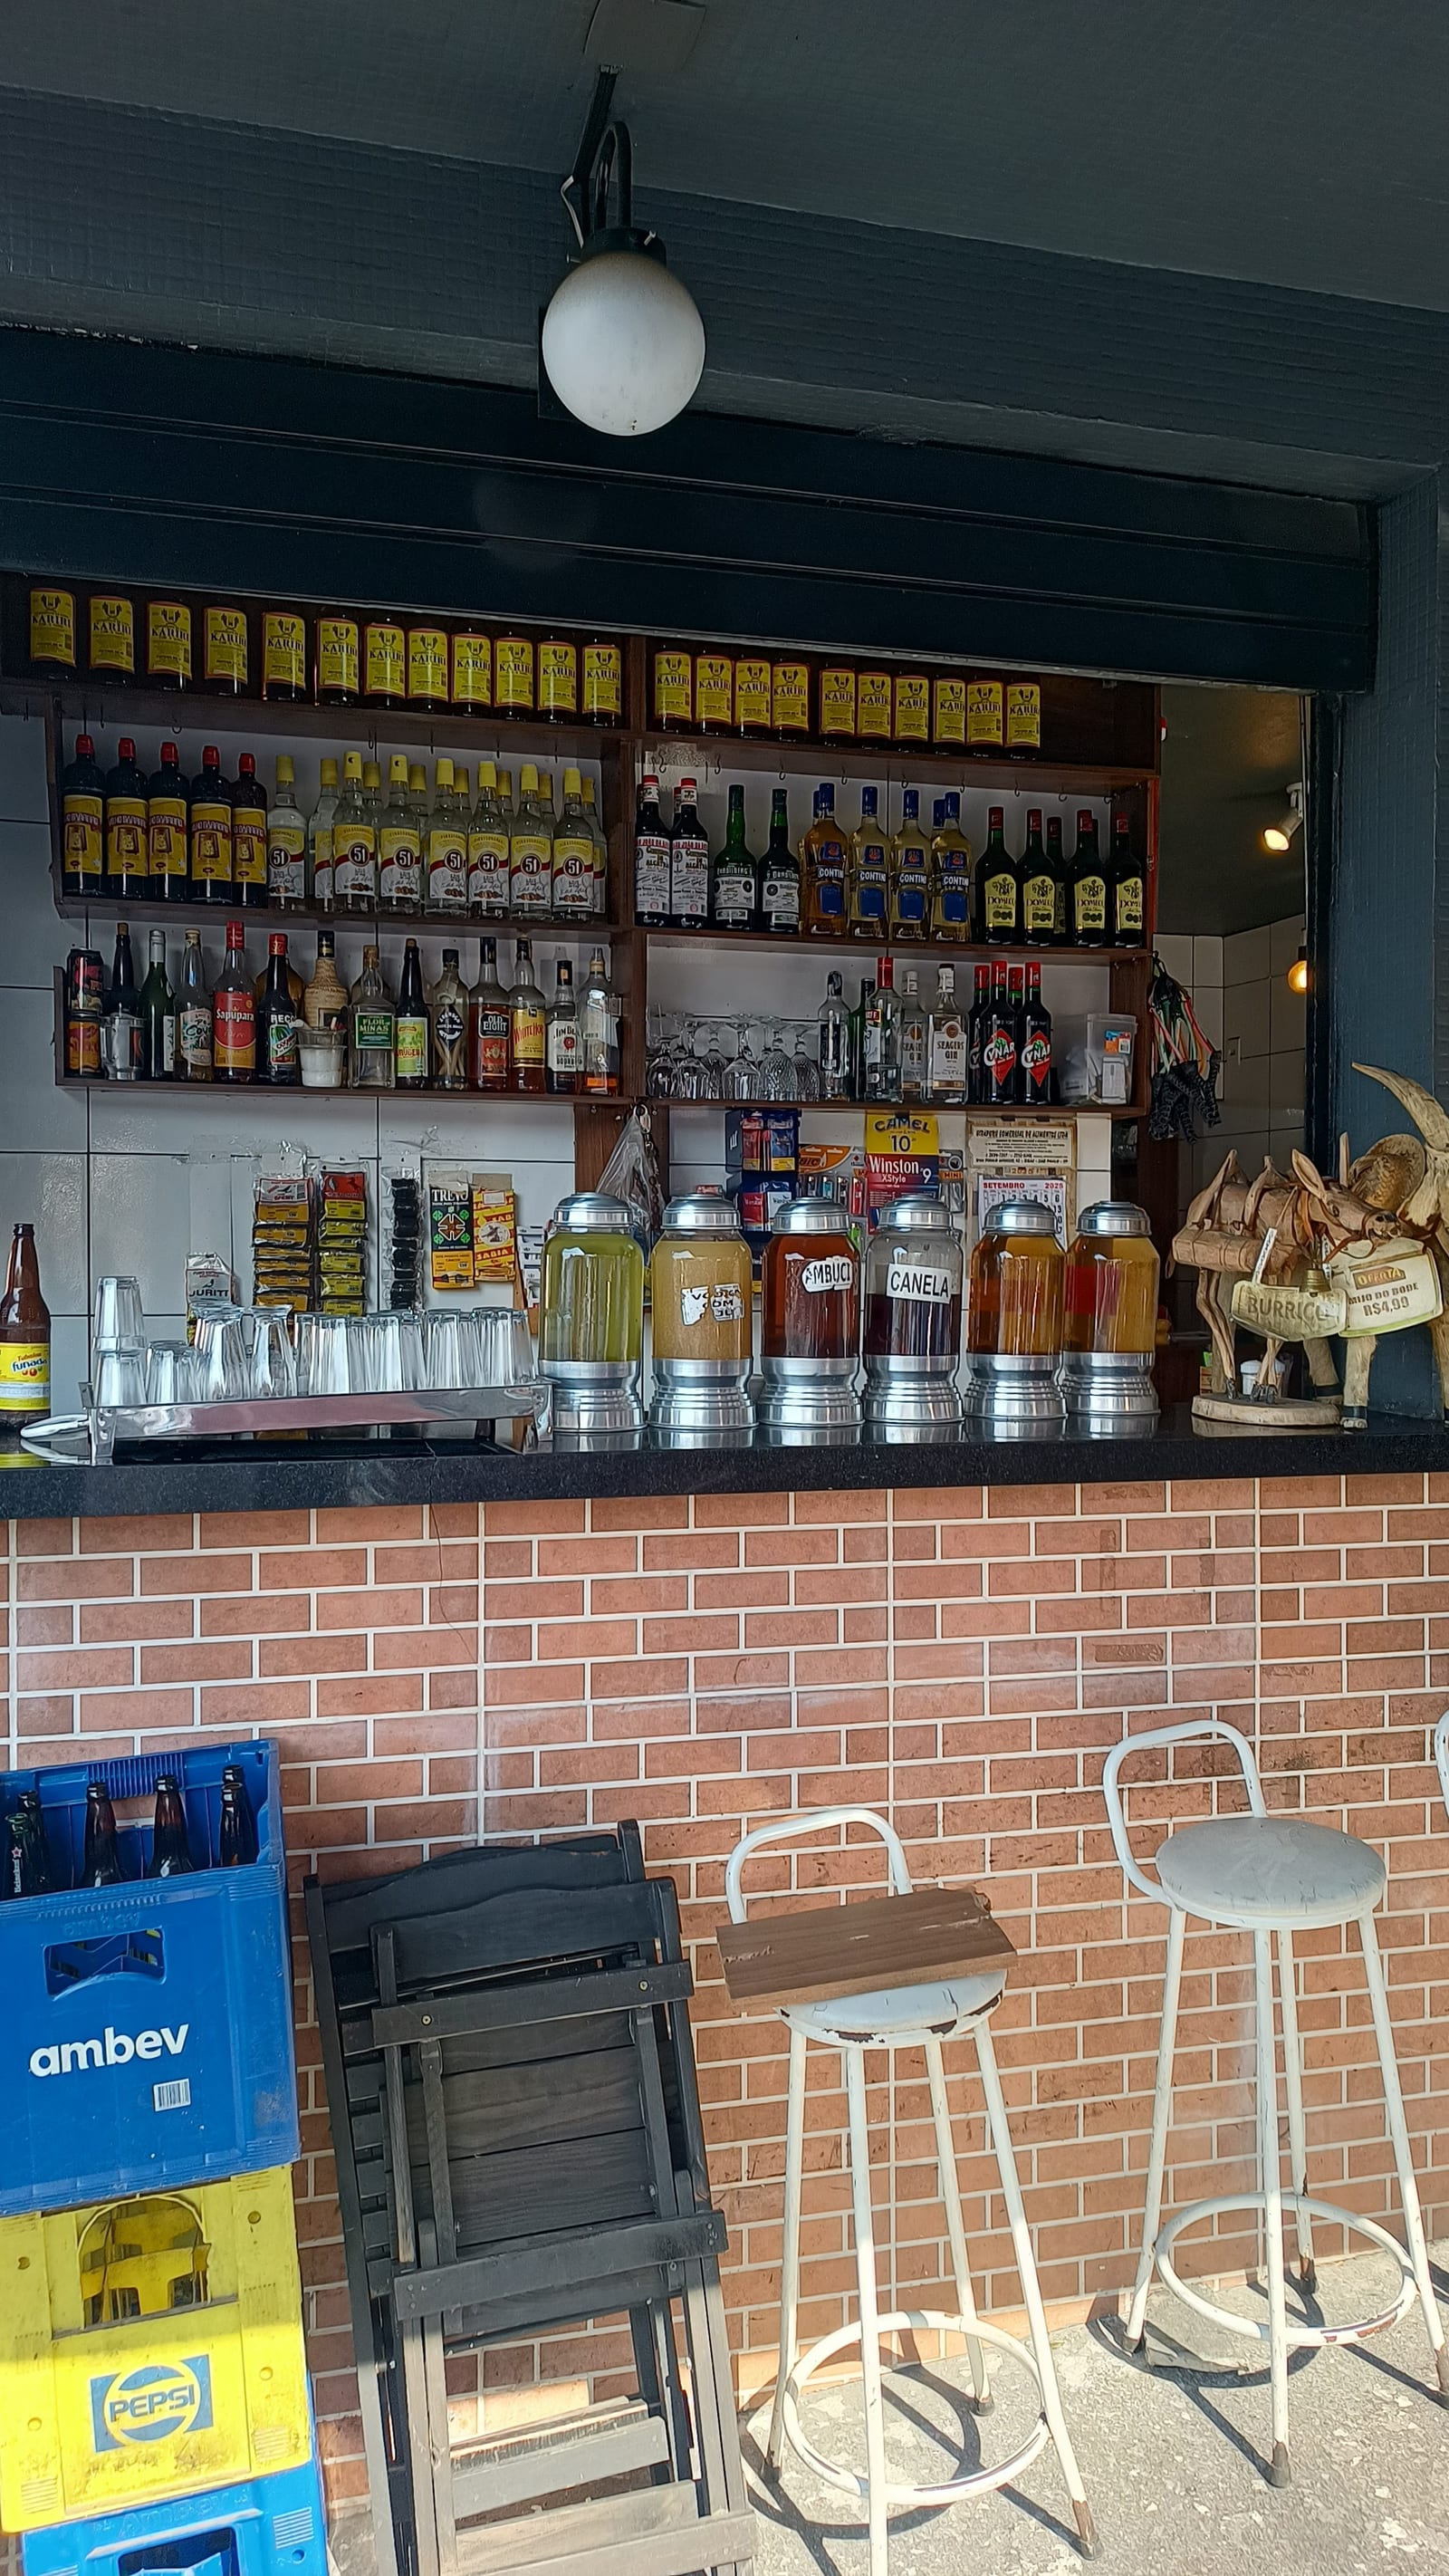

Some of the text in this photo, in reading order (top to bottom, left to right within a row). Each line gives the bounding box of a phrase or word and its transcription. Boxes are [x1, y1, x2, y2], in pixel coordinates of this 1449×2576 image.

[274, 848, 286, 863] 51
[354, 847, 366, 863] 51
[399, 851, 411, 867] 51
[450, 853, 461, 869] 51
[483, 856, 494, 870] 51
[525, 858, 537, 872] 51
[568, 860, 580, 875] 51
[216, 1008, 254, 1023] Sapupara
[945, 1051, 958, 1060] GIN
[874, 1117, 931, 1133] CAMEL
[890, 1135, 911, 1152] 10
[868, 1155, 919, 1175] Winston
[891, 1271, 948, 1298] CANELA
[1358, 1267, 1401, 1288] OFERTA
[188, 1289, 229, 1297] JURITI
[1376, 1289, 1389, 1299] DO
[1392, 1283, 1418, 1295] BODE
[1363, 1297, 1409, 1318] R$4,99
[30, 2023, 189, 2078] ambev
[110, 2384, 195, 2423] PEPSI
